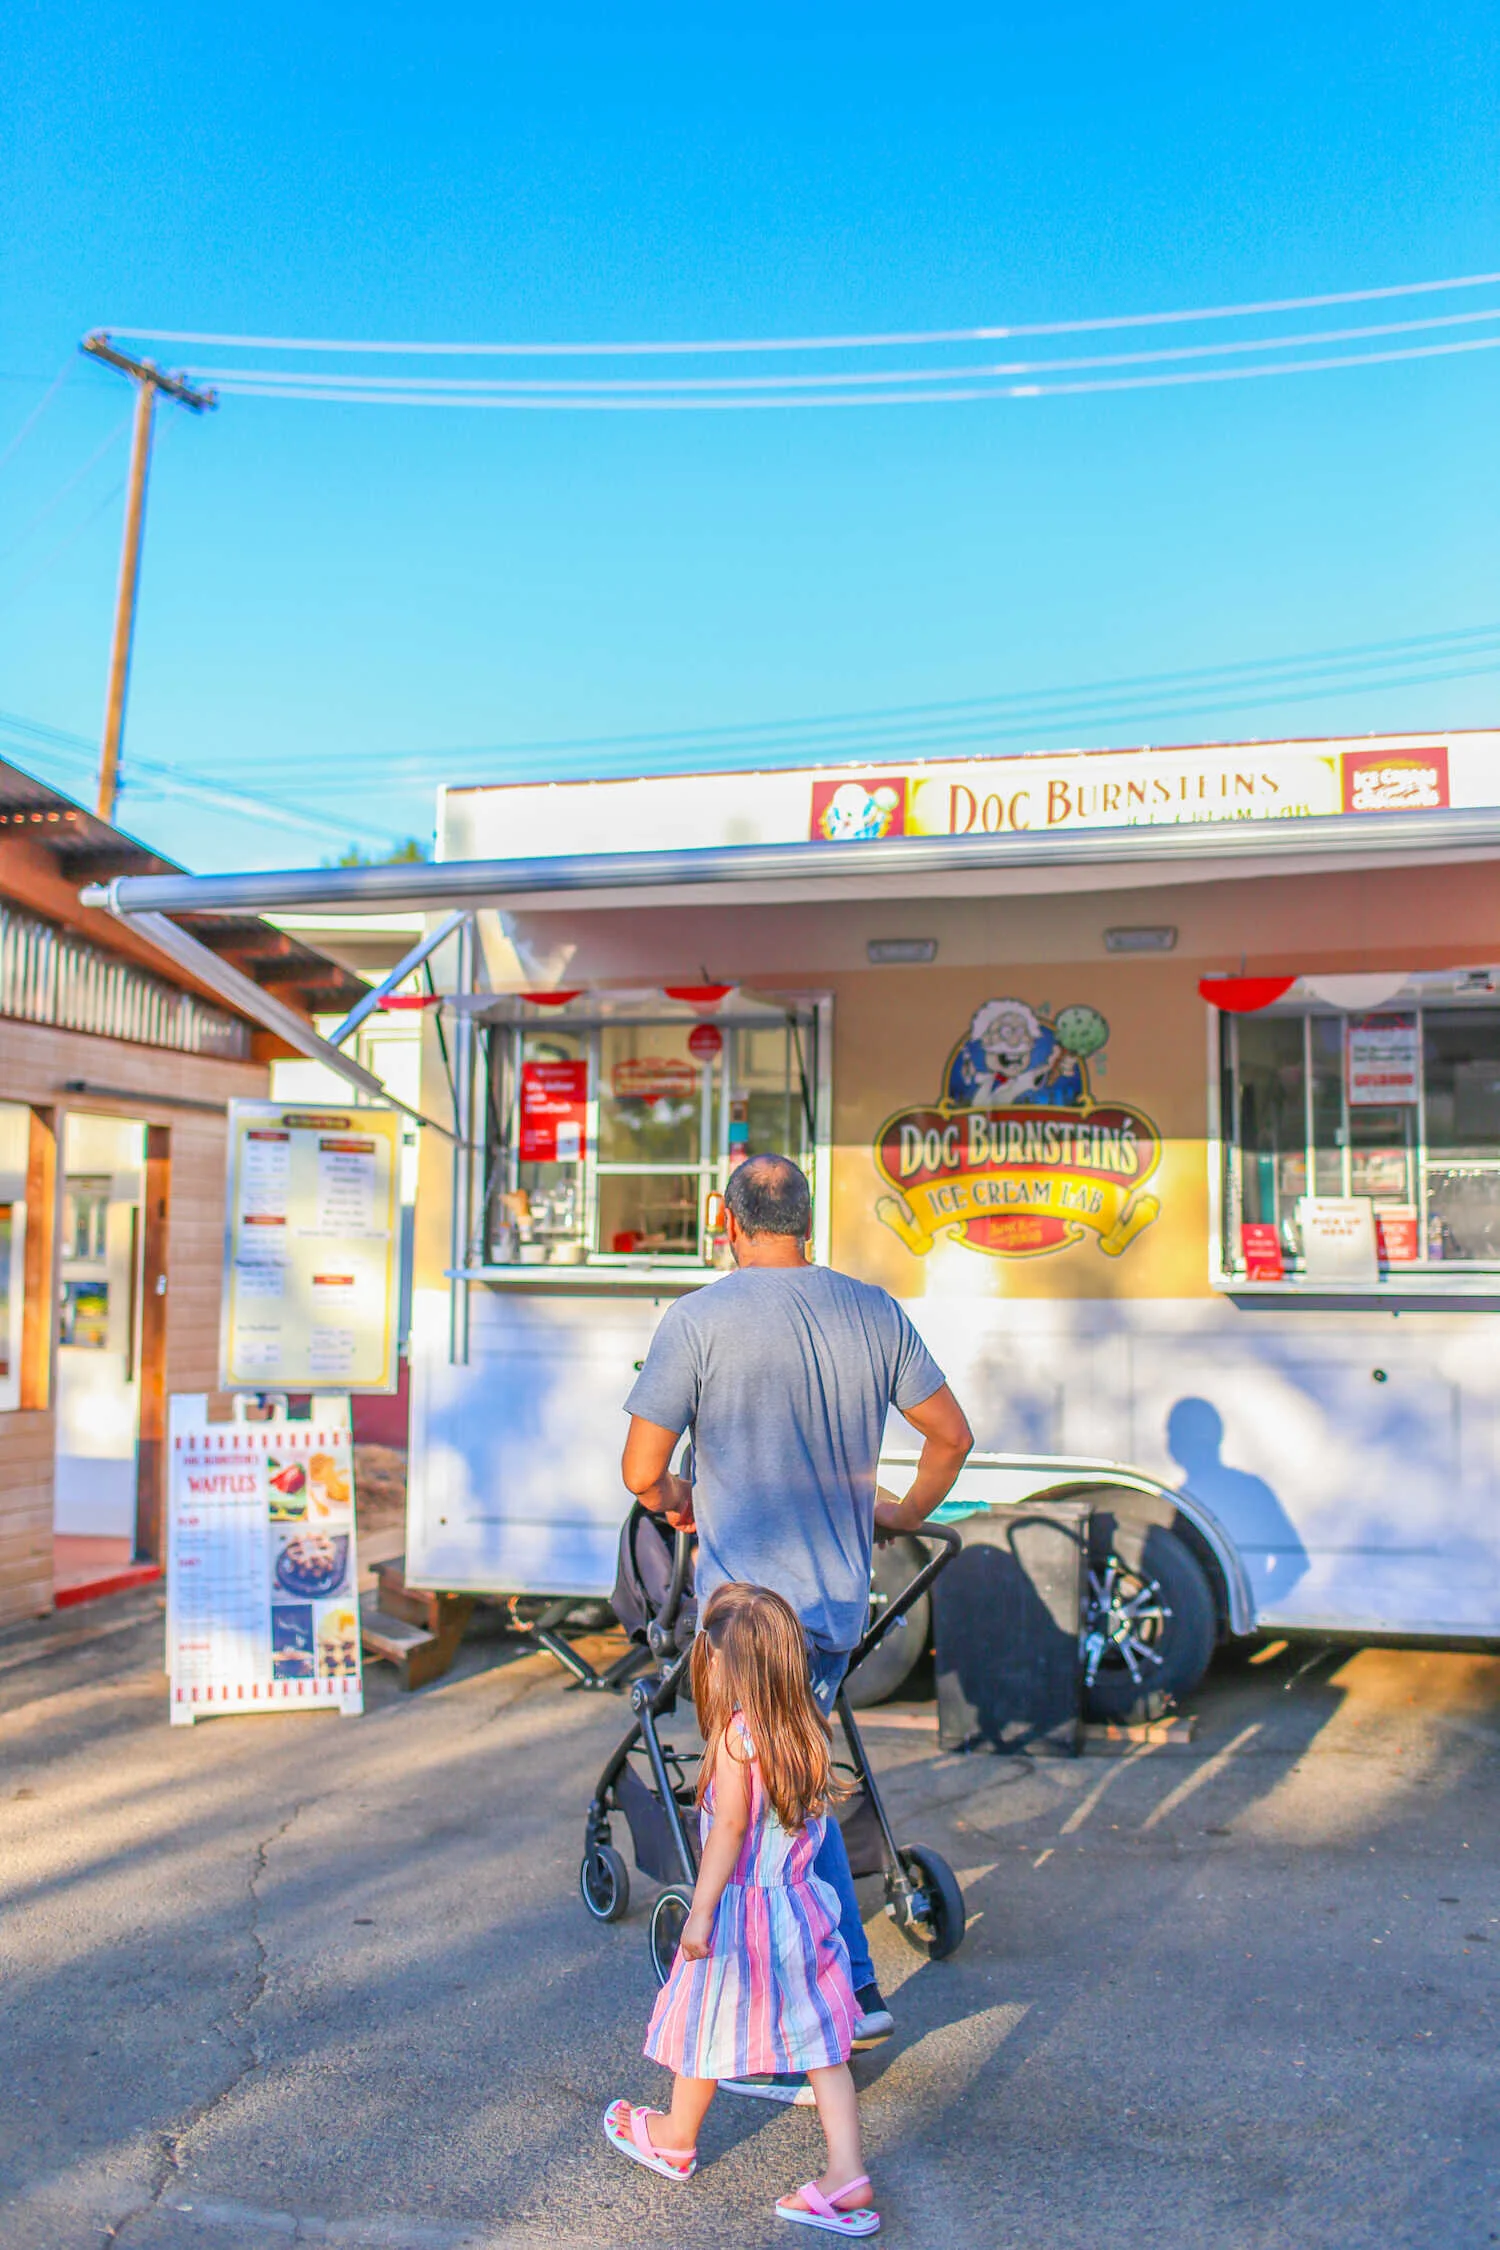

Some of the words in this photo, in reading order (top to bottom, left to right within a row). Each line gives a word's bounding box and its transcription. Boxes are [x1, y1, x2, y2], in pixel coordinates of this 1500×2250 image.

[948, 784, 1030, 834] DOC
[900, 1123, 960, 1177] DOC
[967, 1114, 1139, 1176] BURNSTEIN'S
[926, 1184, 968, 1217] ICE
[971, 1179, 1051, 1205] CREAM
[1059, 1181, 1104, 1214] LAB
[187, 1473, 257, 1494] WAFFLES
